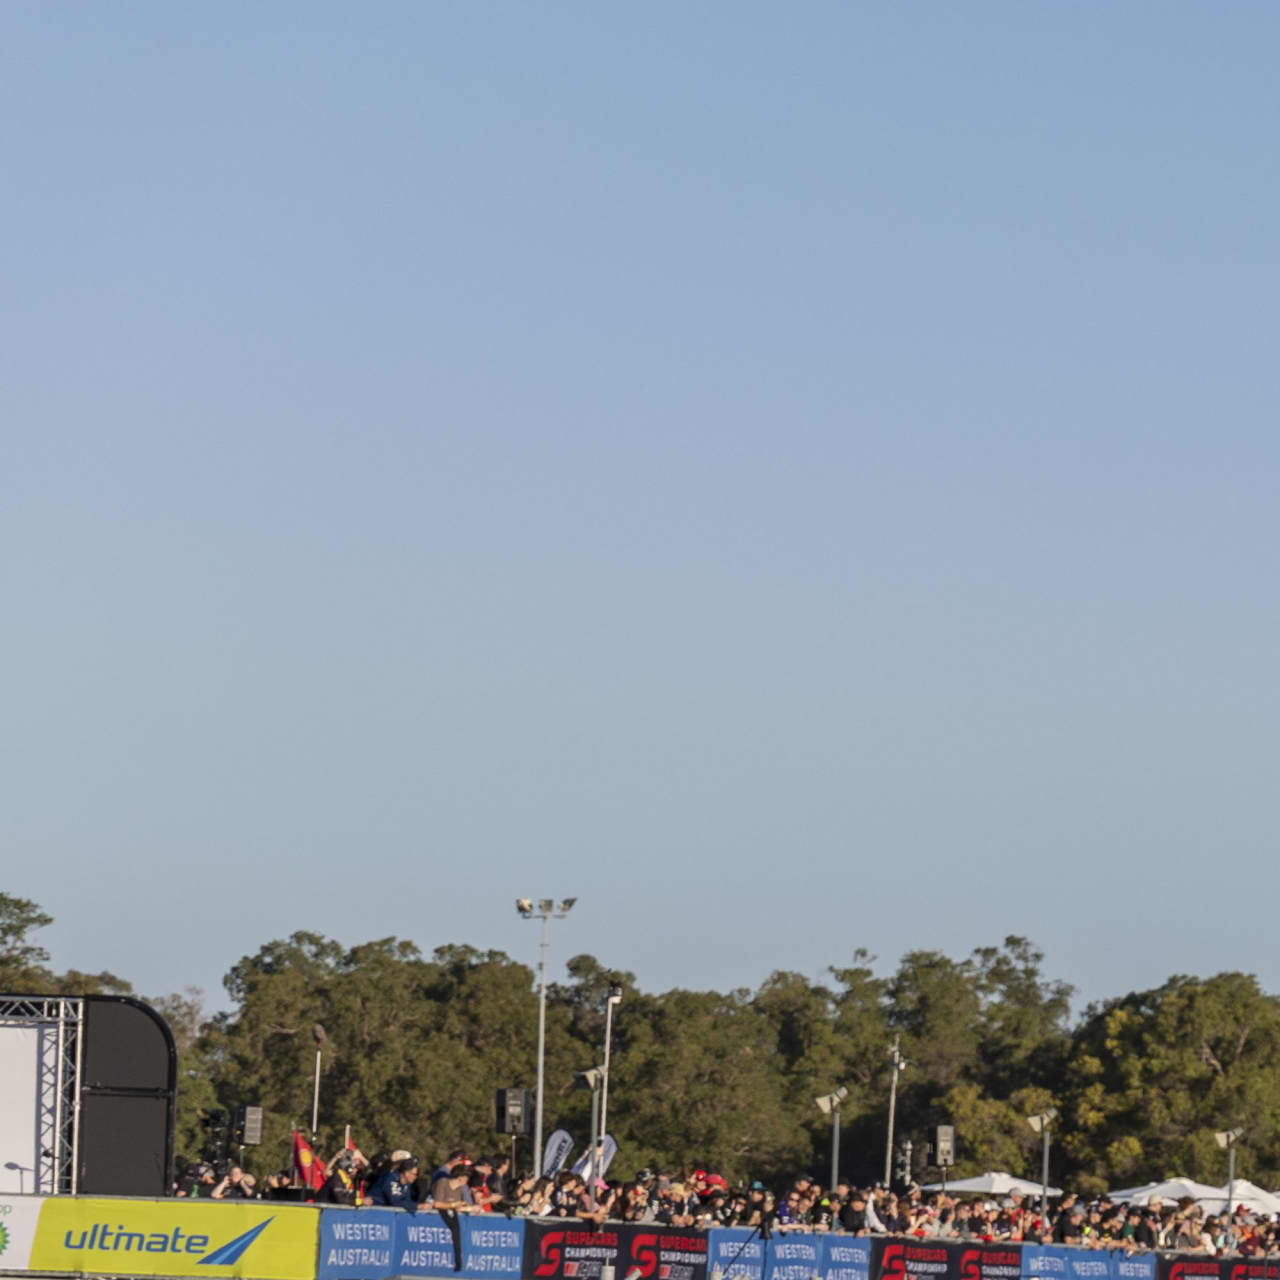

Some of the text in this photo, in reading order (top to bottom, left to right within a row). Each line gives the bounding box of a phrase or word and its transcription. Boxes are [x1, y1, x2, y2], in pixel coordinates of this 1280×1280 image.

[64, 1224, 208, 1254] ultimate
[332, 1223, 390, 1241] WESTERN
[407, 1226, 453, 1243] WESTER
[471, 1230, 520, 1248] WESTERN
[565, 1231, 618, 1246] SUPERCARS
[327, 1249, 390, 1266] AUSTRALIA
[719, 1242, 761, 1258] WESTERN
[774, 1244, 817, 1260] WESTERN
[830, 1247, 867, 1264] WESTERN
[400, 1251, 455, 1268] AUSTRAL
[466, 1255, 520, 1272] AUSTRALIA
